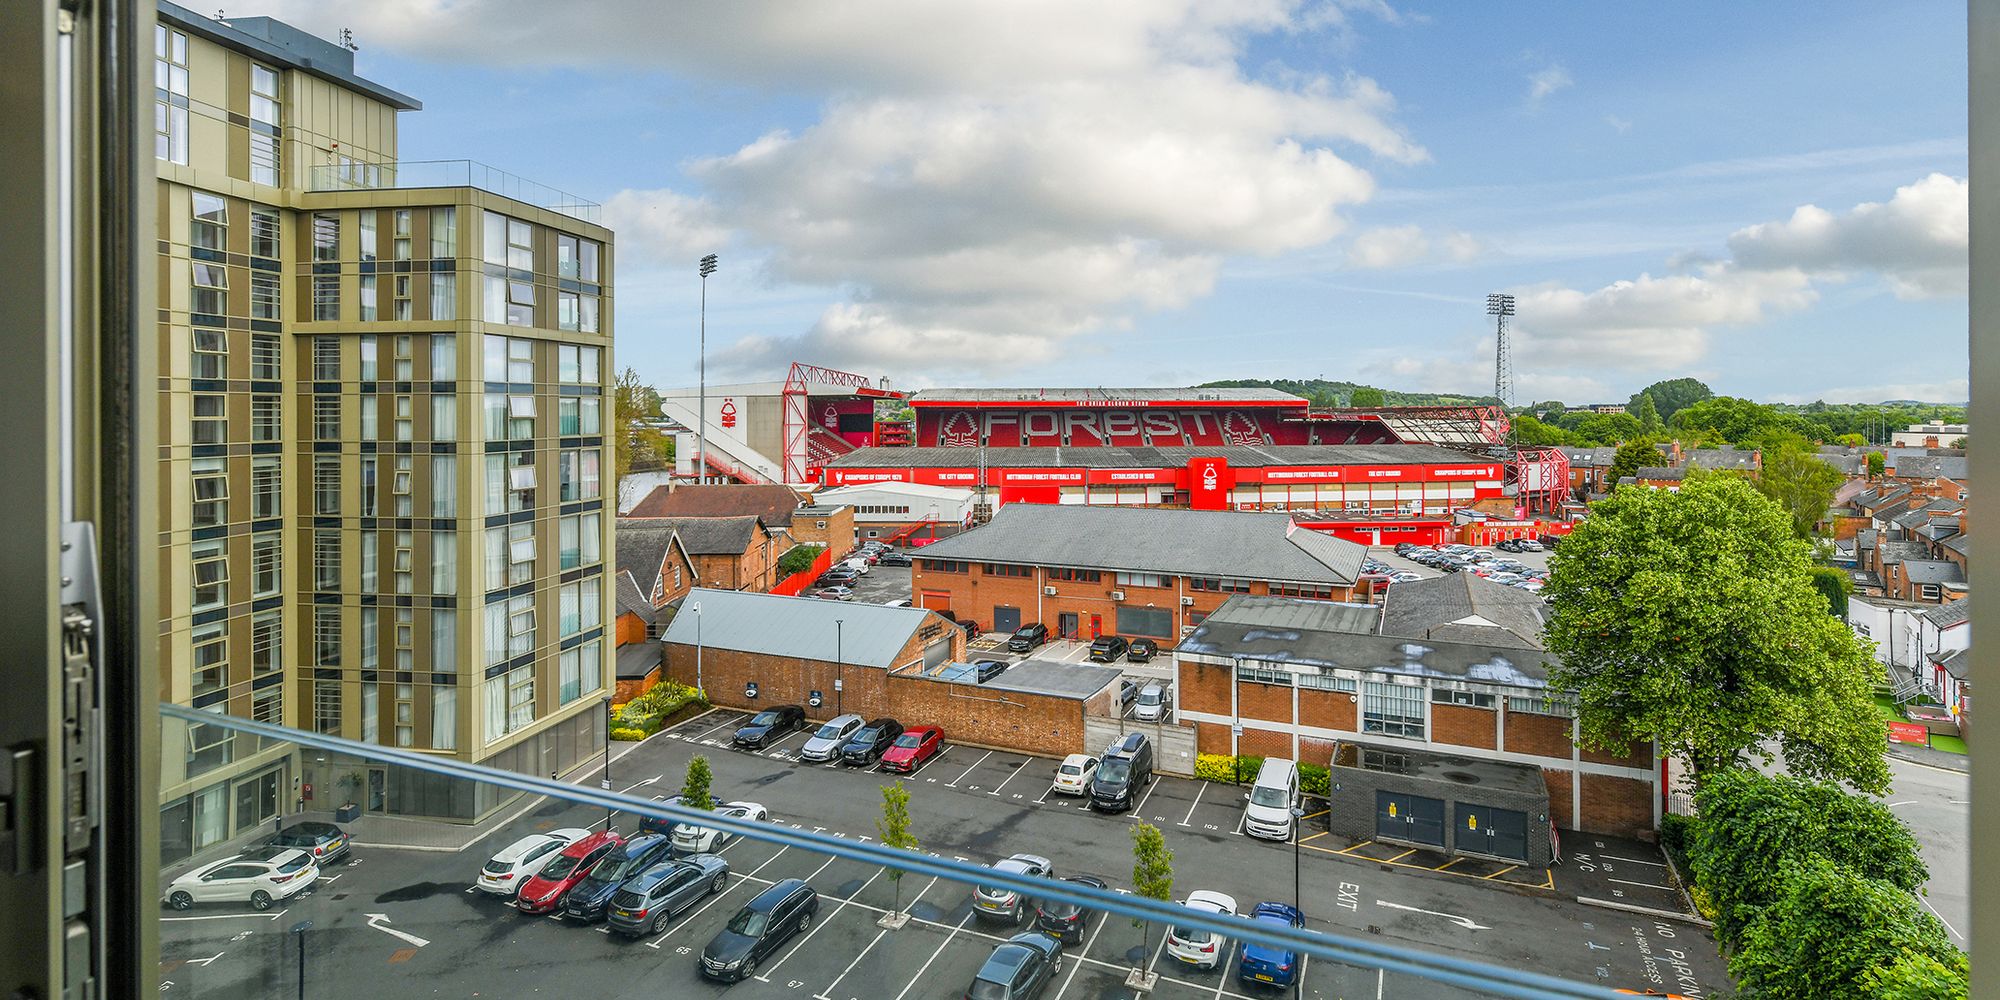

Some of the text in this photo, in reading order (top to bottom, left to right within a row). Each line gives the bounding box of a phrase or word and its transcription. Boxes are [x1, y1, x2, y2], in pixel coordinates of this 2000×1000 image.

[844, 473, 869, 481] CHAMPIONS
[1204, 823, 1218, 831] 102
[1336, 881, 1360, 913] EXIT
[1653, 921, 1676, 938] NO
[675, 945, 692, 956] 65
[1642, 954, 1663, 984] ACCESS
[1664, 948, 1705, 1000] PARKIN
[787, 979, 804, 989] 67
